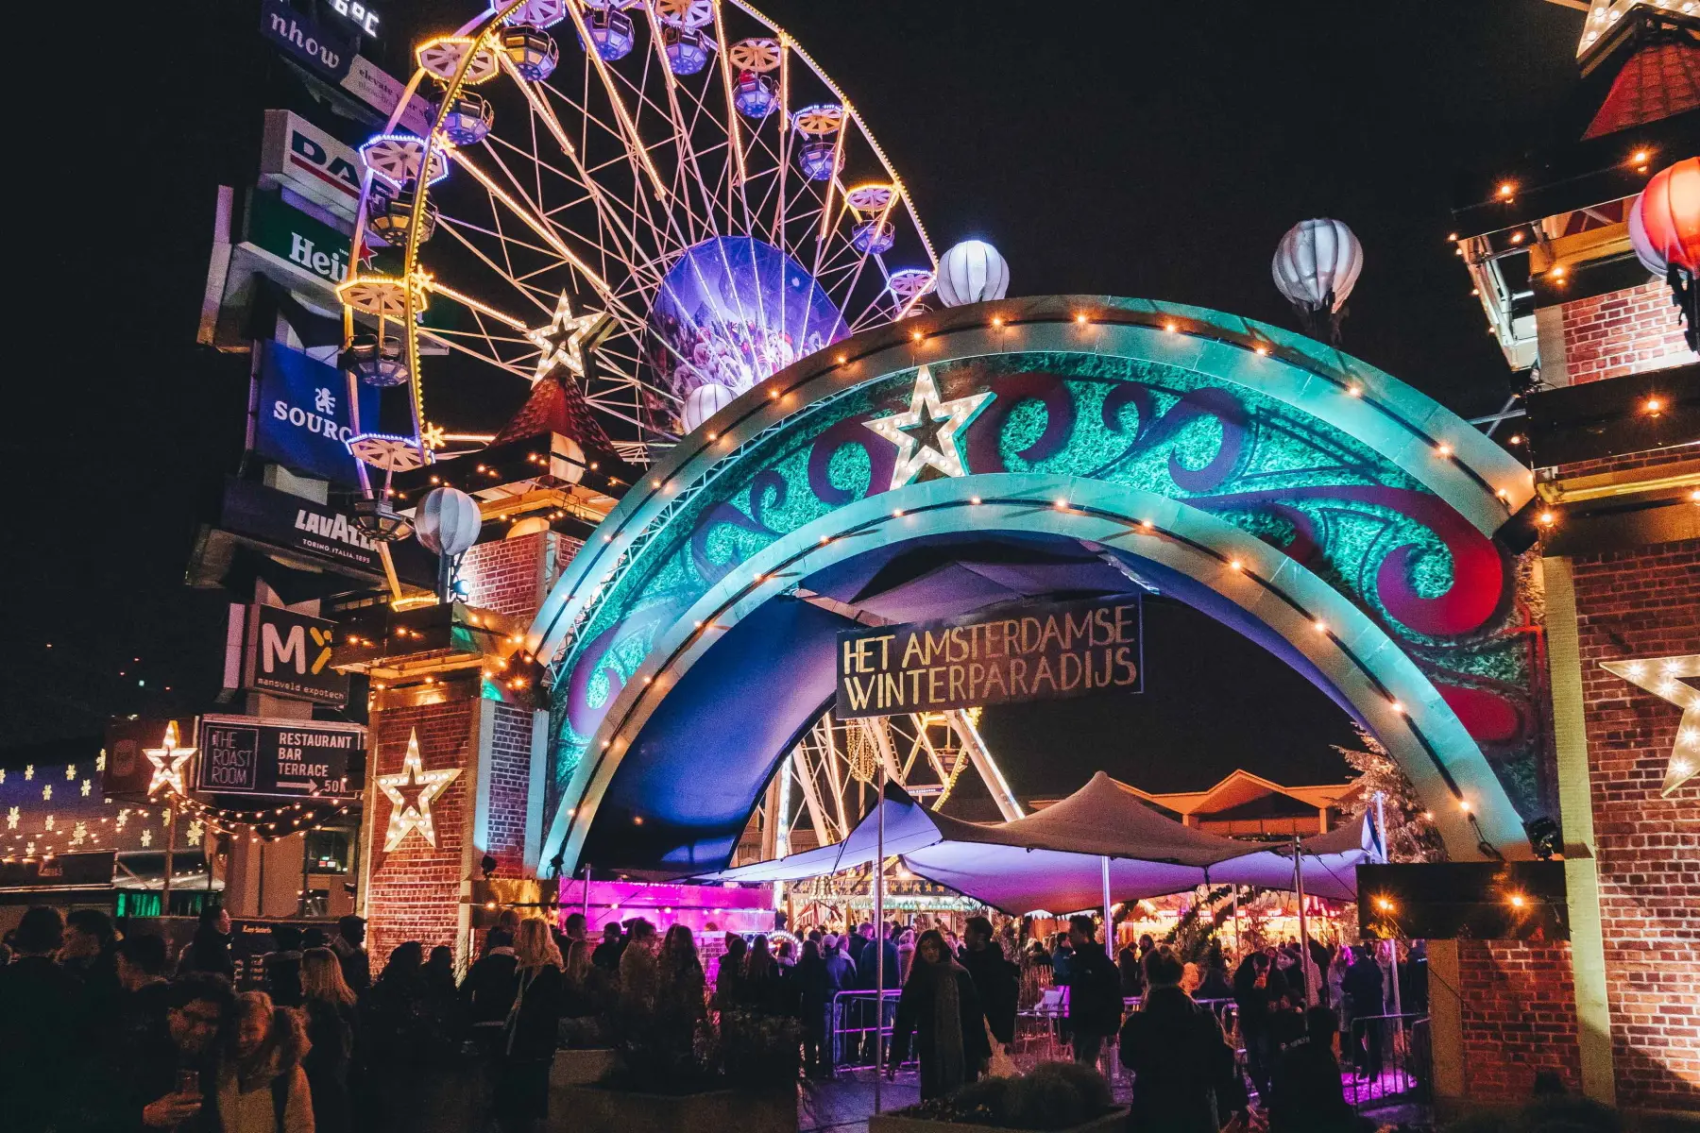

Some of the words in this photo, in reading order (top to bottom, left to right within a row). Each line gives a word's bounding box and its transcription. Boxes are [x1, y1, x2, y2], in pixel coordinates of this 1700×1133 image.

[270, 12, 340, 69] nhow
[843, 633, 896, 675] HET
[901, 604, 1136, 669] AMSTERDAMSE
[257, 677, 301, 692] mansveld
[303, 685, 344, 700] expotech
[844, 646, 1138, 711] WINTERPARADIJS
[213, 730, 238, 749] THE
[279, 732, 352, 749] RESTAURANT
[211, 748, 253, 768] ROAST
[278, 747, 303, 761] BAR
[210, 765, 247, 785] ROOM
[278, 762, 329, 777] TERRACE
